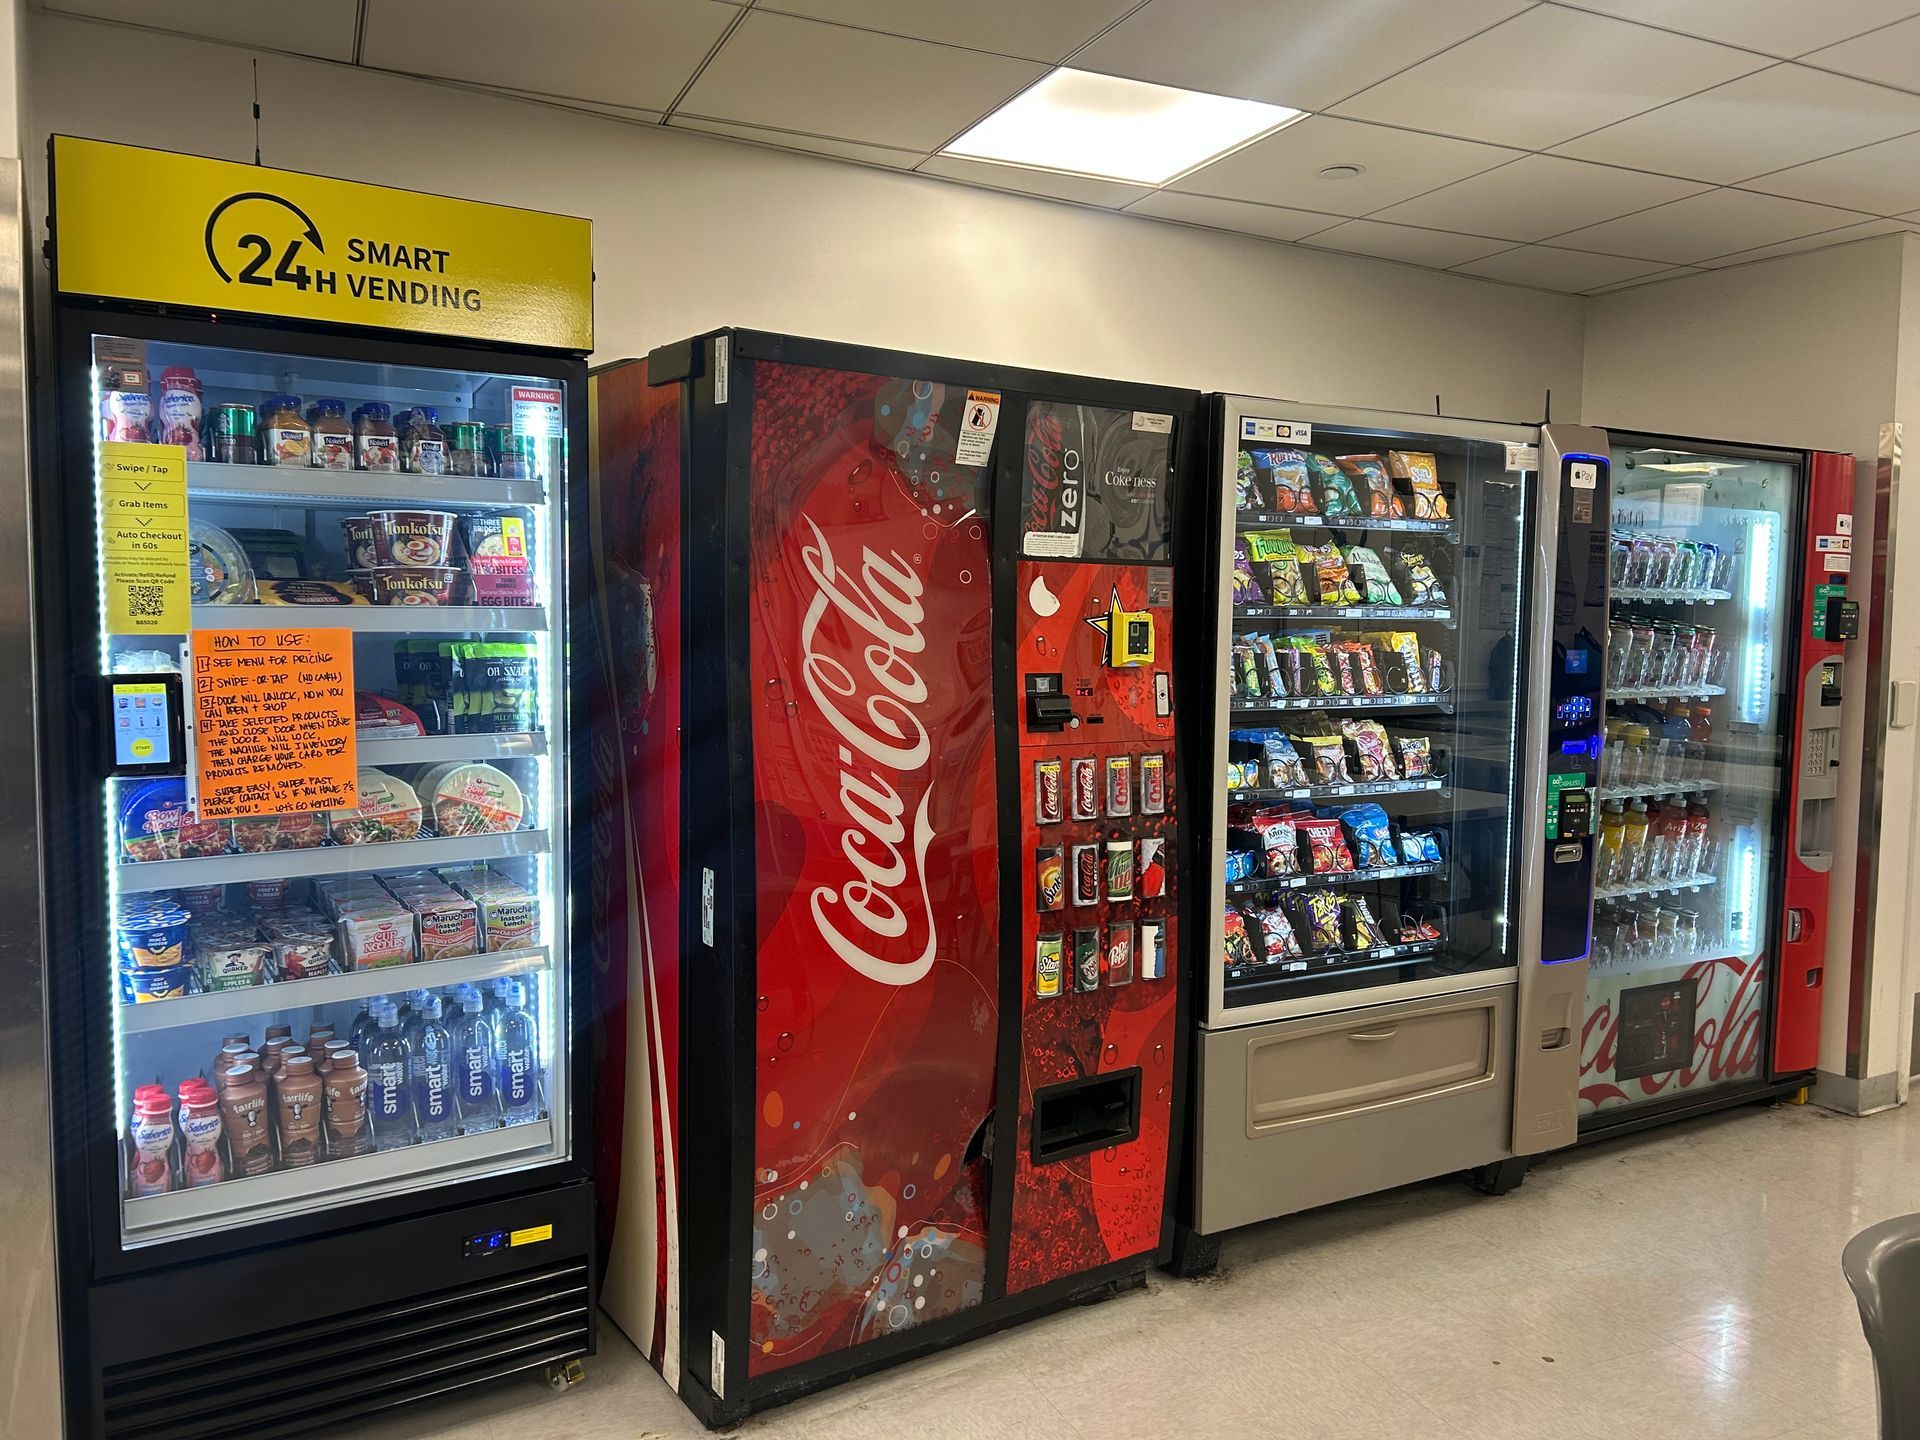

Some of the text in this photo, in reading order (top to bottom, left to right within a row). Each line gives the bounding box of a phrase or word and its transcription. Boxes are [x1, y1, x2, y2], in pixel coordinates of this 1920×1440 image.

[347, 238, 449, 274] SMART
[346, 273, 482, 312] VENDING
[518, 391, 555, 401] WARNING
[976, 394, 999, 405] WARNING
[117, 463, 145, 473] Swipe
[152, 465, 168, 474] Tap
[1117, 466, 1131, 475] Enjoy
[1581, 470, 1593, 483] Pay
[1060, 448, 1081, 529] zero
[143, 501, 168, 509] Items
[140, 531, 182, 540] Checkout
[386, 520, 445, 536] Tonkotsu
[382, 575, 443, 590] Tonkotsu
[481, 596, 503, 607] EGG
[214, 633, 310, 648] HOW TO USE:
[213, 658, 232, 668] SEE
[237, 656, 265, 667] MENU
[268, 656, 287, 666] FOR
[269, 674, 289, 685] TAP
[215, 695, 238, 706] DOOR
[304, 691, 324, 700] NOW
[328, 688, 344, 697] YOU
[204, 708, 222, 718] CAN
[226, 704, 249, 716] OPEN
[263, 702, 288, 712] SHOP
[216, 710, 339, 729] TAKE SELECTED PRODUCTS
[219, 717, 352, 737] AND CLOSE DOOR WHEN DONE
[208, 738, 228, 747] THE
[232, 735, 260, 744] DOOR
[208, 748, 228, 757] THE
[229, 745, 268, 756] MACHINE
[295, 736, 347, 751] INVENTORY
[802, 511, 937, 986] Coca-Cola
[210, 748, 346, 768] THEN CHARGE YOUR CARD FOR
[205, 768, 250, 781] PRODUCTS
[215, 787, 244, 797] SUPER
[277, 778, 306, 788] SUPER
[308, 776, 335, 785] FAST
[1080, 764, 1095, 813] Coca-Cola
[1116, 767, 1129, 807] Coke
[1150, 767, 1163, 804] Coke
[203, 784, 341, 807] PLEASE CONTACT US IF YOU HAVE
[145, 806, 183, 821] Bowl
[203, 806, 234, 817] THANK
[235, 805, 251, 815] YOU
[432, 912, 474, 923] Maruchan
[496, 905, 538, 915] Maruchan
[499, 913, 528, 922] Instant
[435, 920, 463, 930] Instant
[503, 919, 526, 927] Lunch
[374, 929, 398, 941] CUP
[439, 927, 461, 935] Lunch
[364, 937, 406, 953] NOODLES
[222, 965, 249, 974] QUAKER
[466, 1046, 483, 1097] smart
[508, 1049, 525, 1099] smart
[283, 1091, 314, 1103] fairlife
[425, 1064, 443, 1116] smart
[233, 1098, 265, 1113] fairlife
